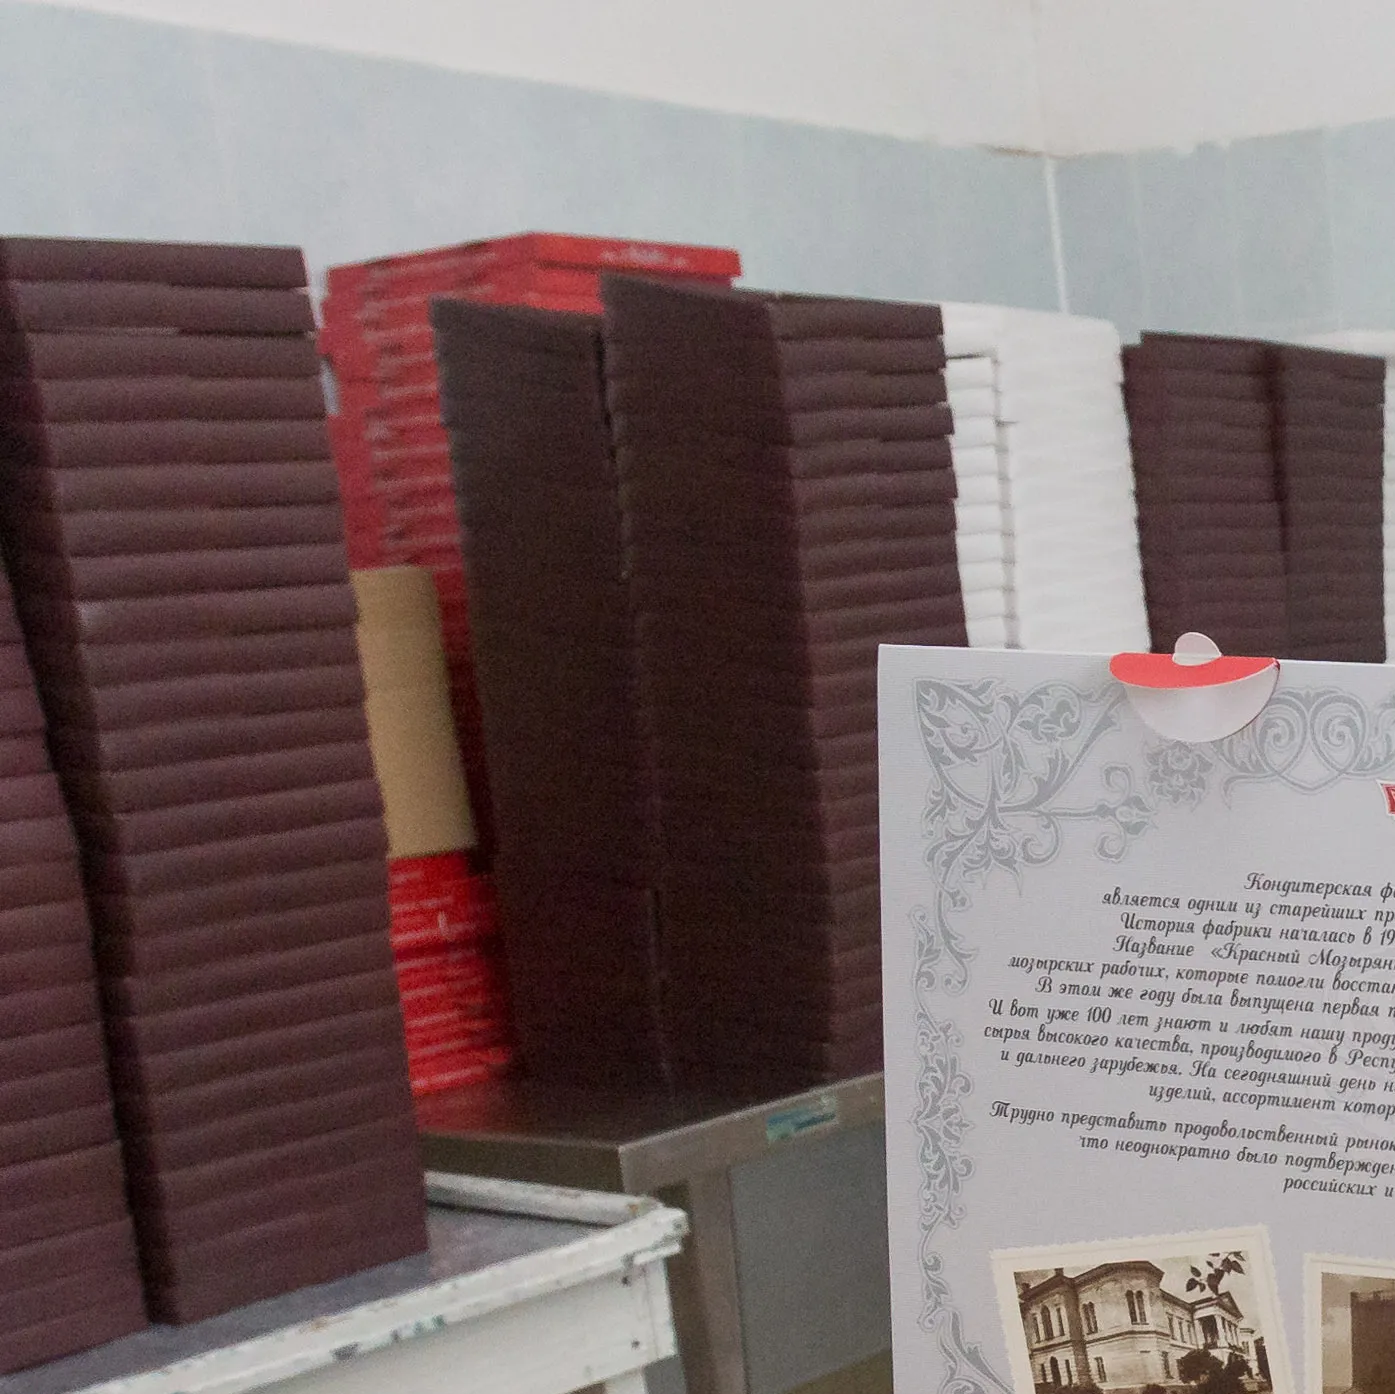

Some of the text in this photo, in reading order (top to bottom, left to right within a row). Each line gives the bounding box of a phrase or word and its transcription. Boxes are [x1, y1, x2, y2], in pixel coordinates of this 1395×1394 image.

[1243, 871, 1373, 901] Кондитерская
[1101, 885, 1181, 910] является
[1186, 898, 1239, 916] одним
[1244, 901, 1262, 920] из
[1268, 903, 1368, 923] старейших
[1120, 911, 1196, 938] История
[1201, 918, 1273, 942] фабрики
[1278, 927, 1356, 945] началась
[1362, 925, 1373, 946] в
[1111, 934, 1195, 960] Название
[1007, 956, 1096, 976] мозырских
[1175, 968, 1250, 989] которые
[1255, 973, 1326, 990] помогли
[1034, 975, 1053, 994] В
[1058, 982, 1102, 998] этом
[1107, 986, 1134, 1000] же
[1138, 988, 1176, 1008] году
[1180, 987, 1224, 1007] была
[1229, 987, 1315, 1015] выпущена
[1321, 996, 1380, 1021] первая
[988, 997, 1004, 1017] И
[1009, 997, 1039, 1019] вот
[1044, 1007, 1080, 1025] уже
[1086, 1005, 1113, 1024] 100
[1116, 1013, 1149, 1028] лет
[1153, 1016, 1212, 1034] знают
[1218, 1020, 1229, 1034] и
[1234, 1019, 1293, 1038] любят
[1299, 1027, 1346, 1047] нашу
[983, 1025, 1031, 1044] сырья
[1036, 1022, 1110, 1047] высокого
[1200, 1039, 1322, 1065] производимого
[1327, 1046, 1339, 1065] в
[1000, 1049, 1010, 1062] и
[1014, 1051, 1087, 1068] дальнего
[1089, 1055, 1183, 1077] зарубежья.
[1188, 1059, 1217, 1079] На
[1223, 1067, 1332, 1089] сегодняшний
[1336, 1077, 1377, 1095] день
[1221, 1091, 1336, 1112] ассортимент
[988, 1100, 1056, 1126] Трудно
[1060, 1110, 1168, 1133] представить
[1173, 1118, 1339, 1147] продовольственный
[1079, 1135, 1109, 1150] что
[1114, 1139, 1231, 1162] неоднократно
[1235, 1145, 1279, 1165] было
[1282, 1177, 1378, 1197] российских
[1383, 1185, 1395, 1198] и
